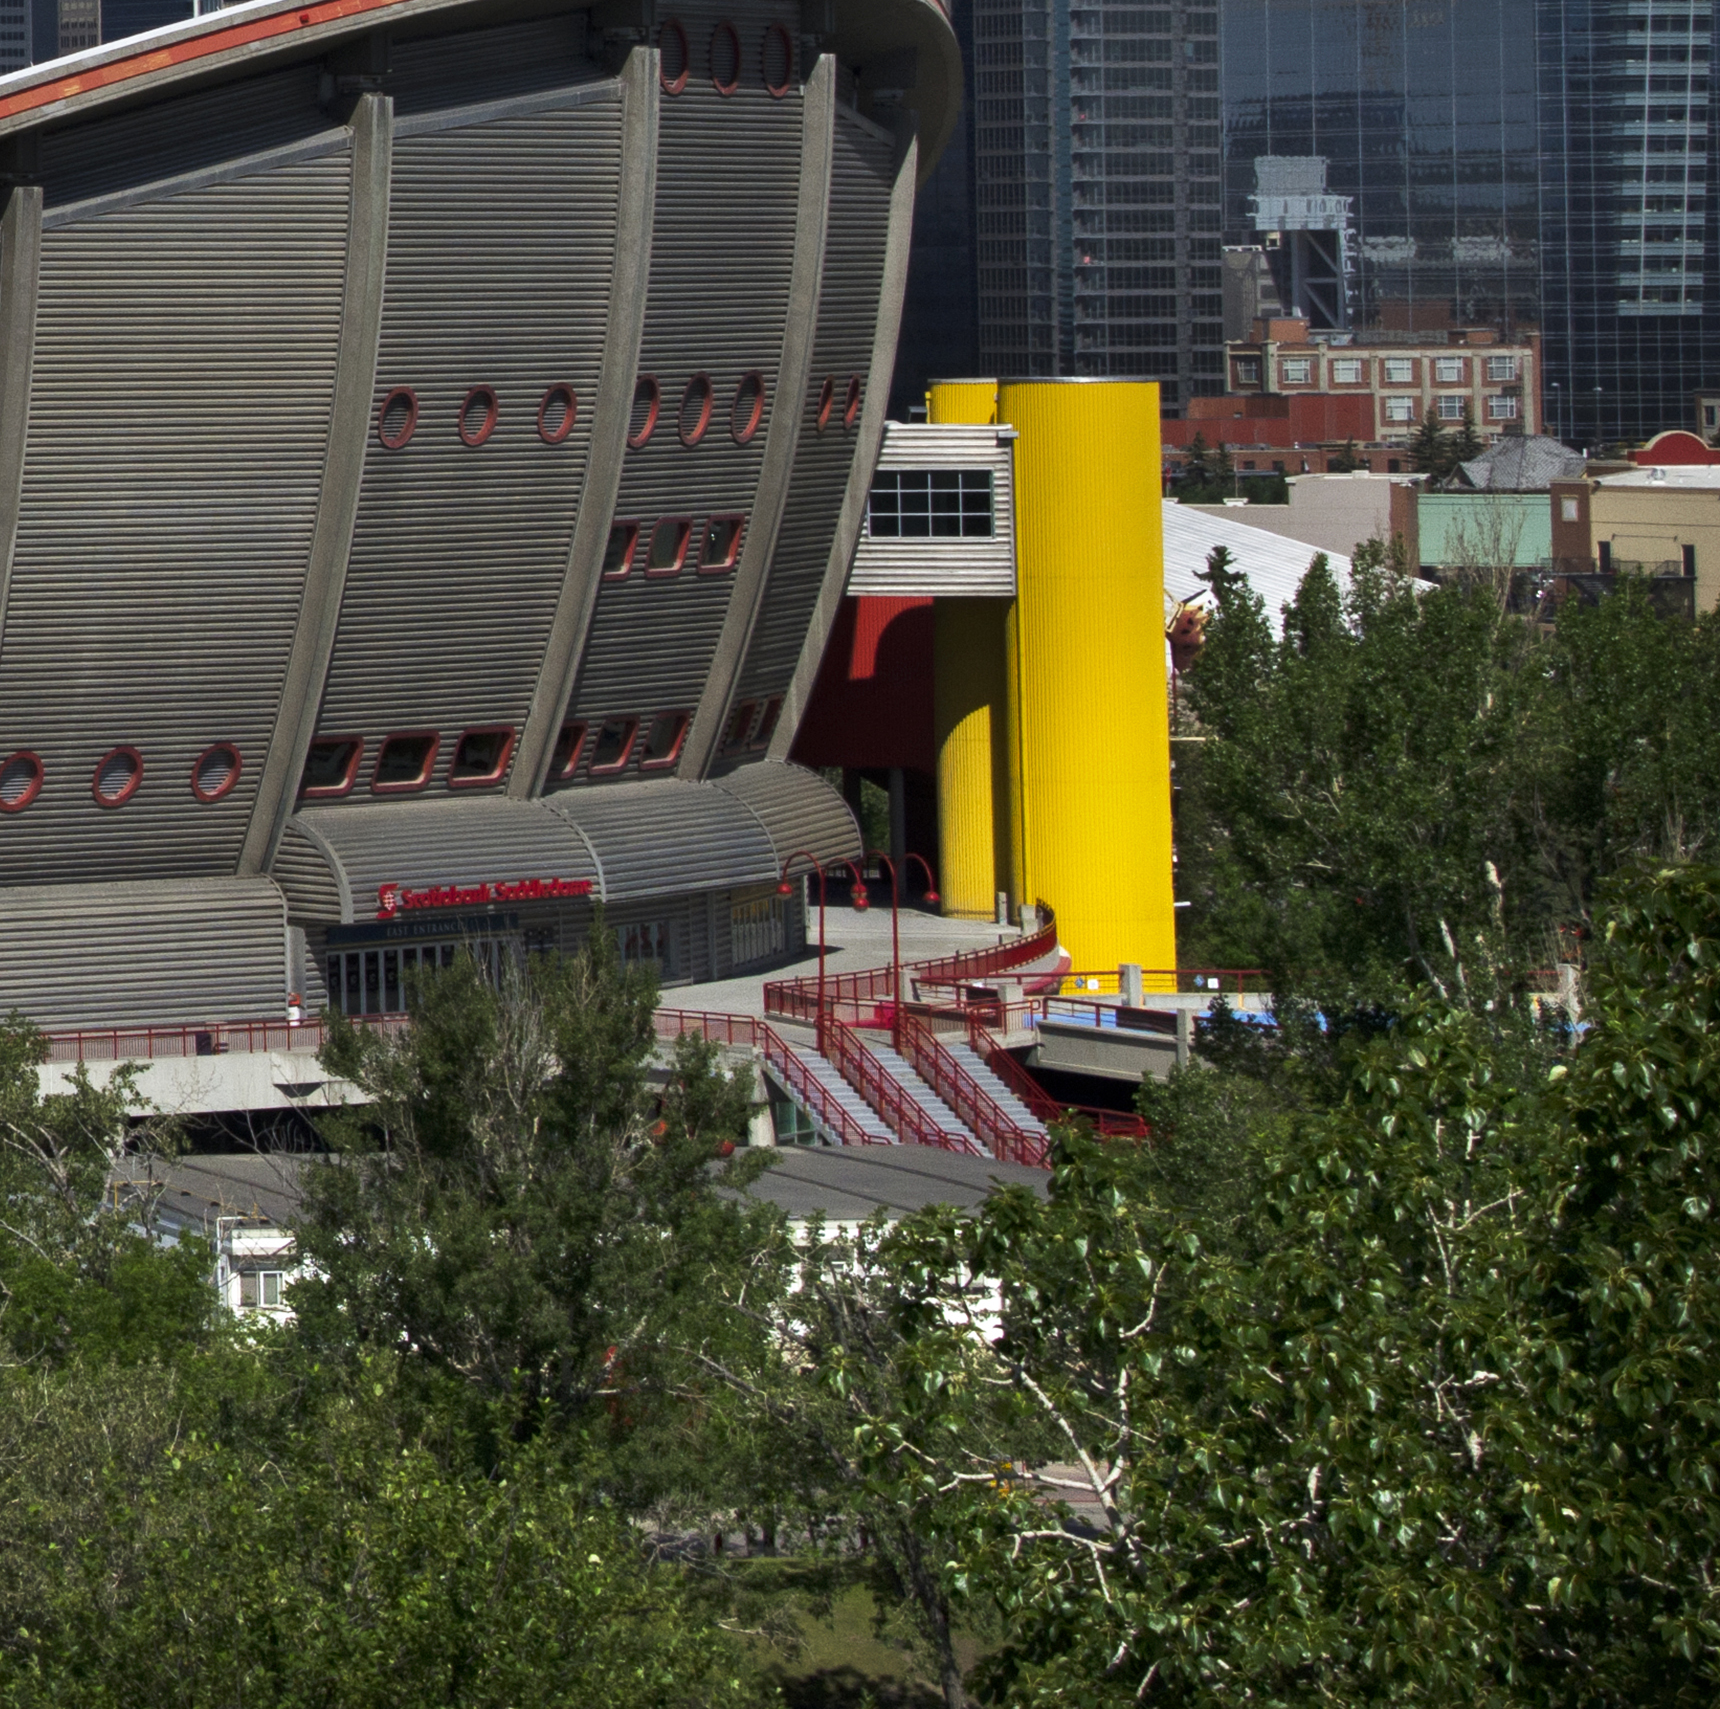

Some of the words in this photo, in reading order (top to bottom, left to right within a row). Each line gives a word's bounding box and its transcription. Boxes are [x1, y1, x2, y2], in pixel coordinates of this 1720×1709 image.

[401, 882, 492, 909] Scotiabank
[494, 878, 593, 901] Saddledome
[387, 926, 408, 937] EAST
